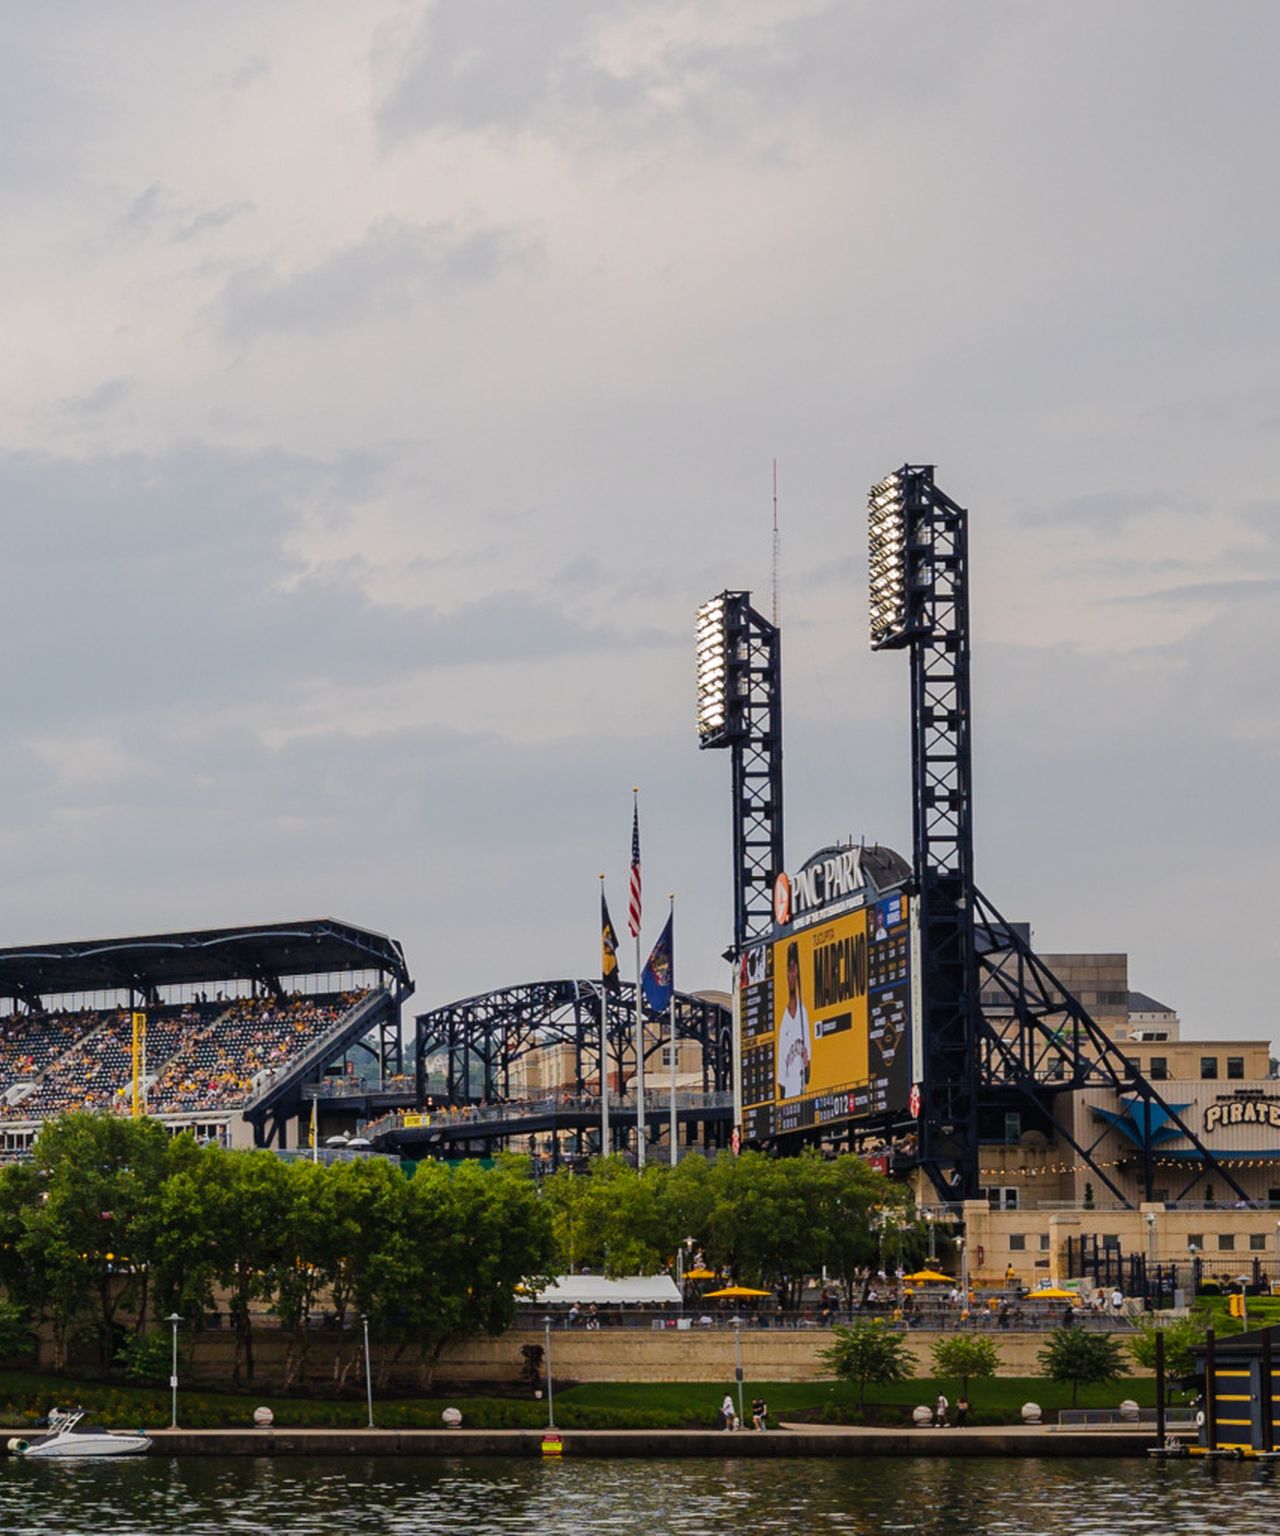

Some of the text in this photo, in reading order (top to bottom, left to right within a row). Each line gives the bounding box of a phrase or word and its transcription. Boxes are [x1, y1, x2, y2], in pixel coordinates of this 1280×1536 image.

[790, 864, 823, 914] PNC
[824, 847, 865, 900] PARK
[813, 931, 865, 1010] MARCANO
